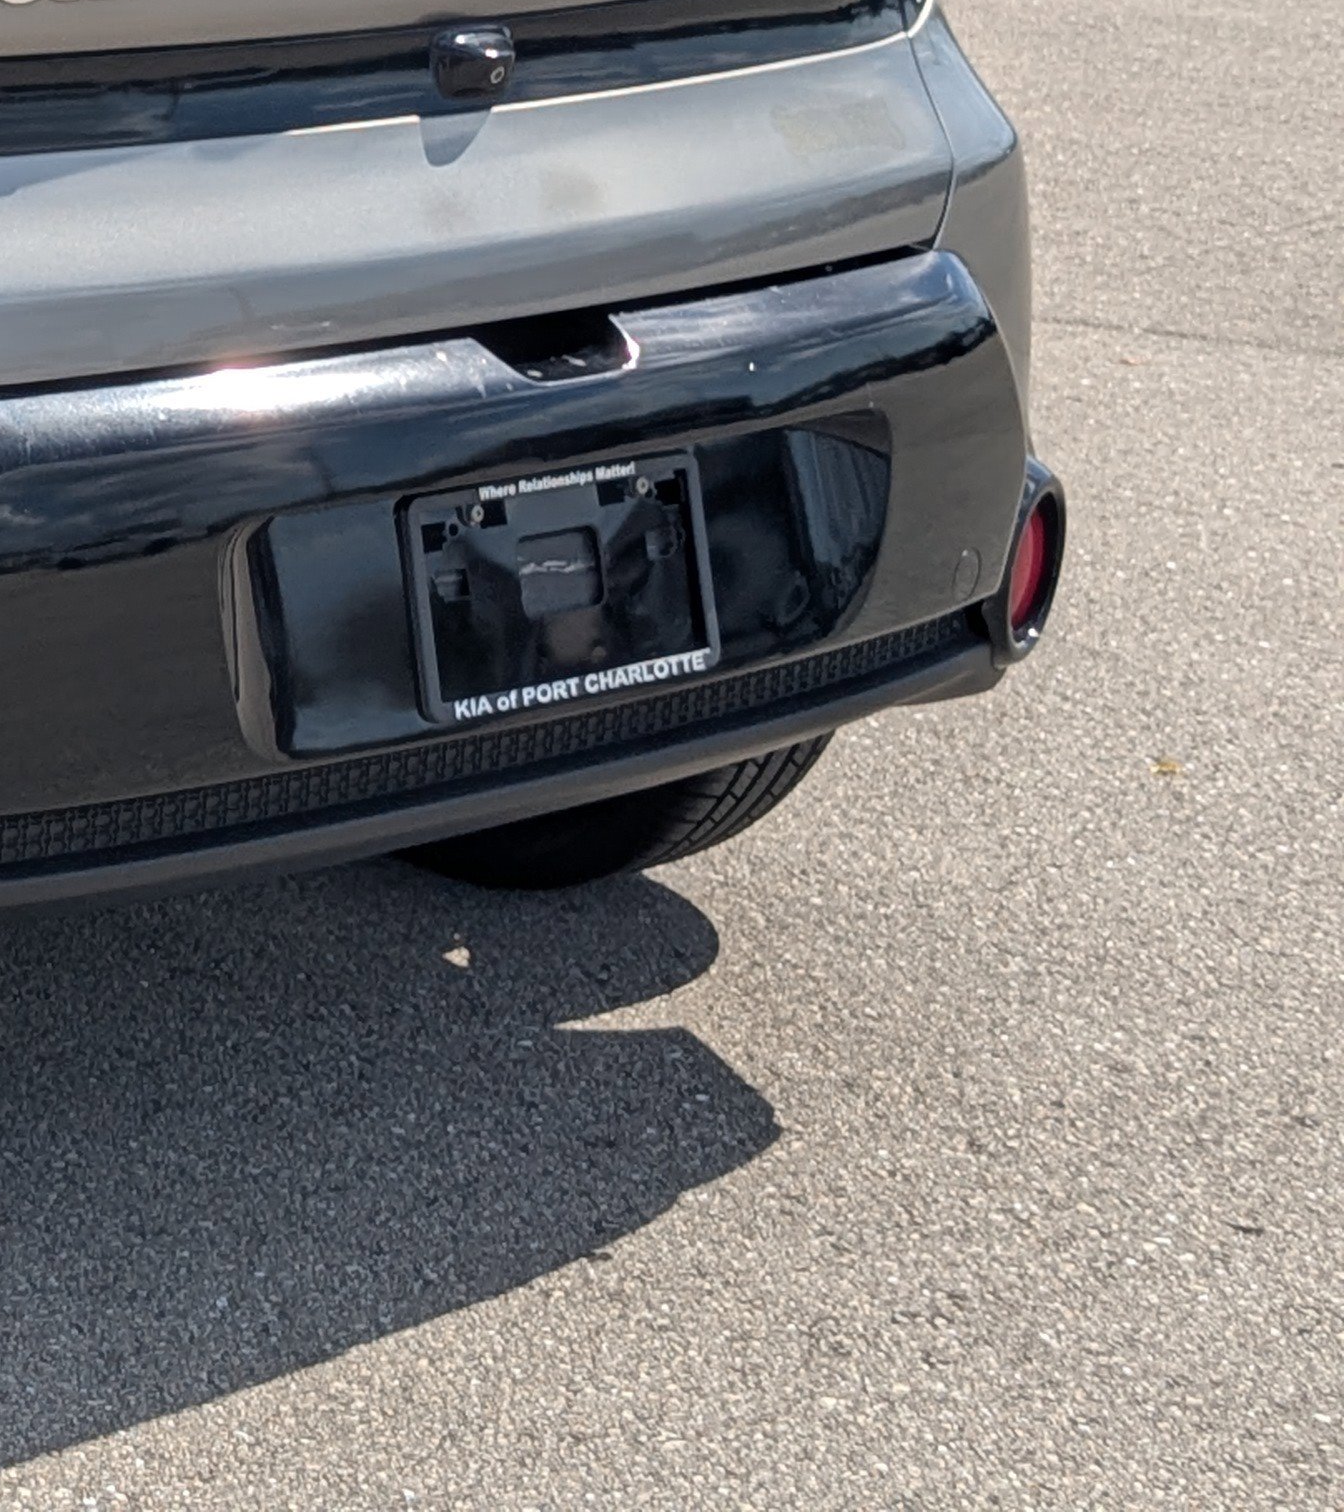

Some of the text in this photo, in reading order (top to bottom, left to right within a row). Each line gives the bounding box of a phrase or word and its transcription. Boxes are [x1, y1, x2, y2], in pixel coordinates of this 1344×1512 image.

[478, 461, 636, 502] Where Relationships Matter!
[453, 651, 708, 721] KIA of PORT CHARLOTTE
